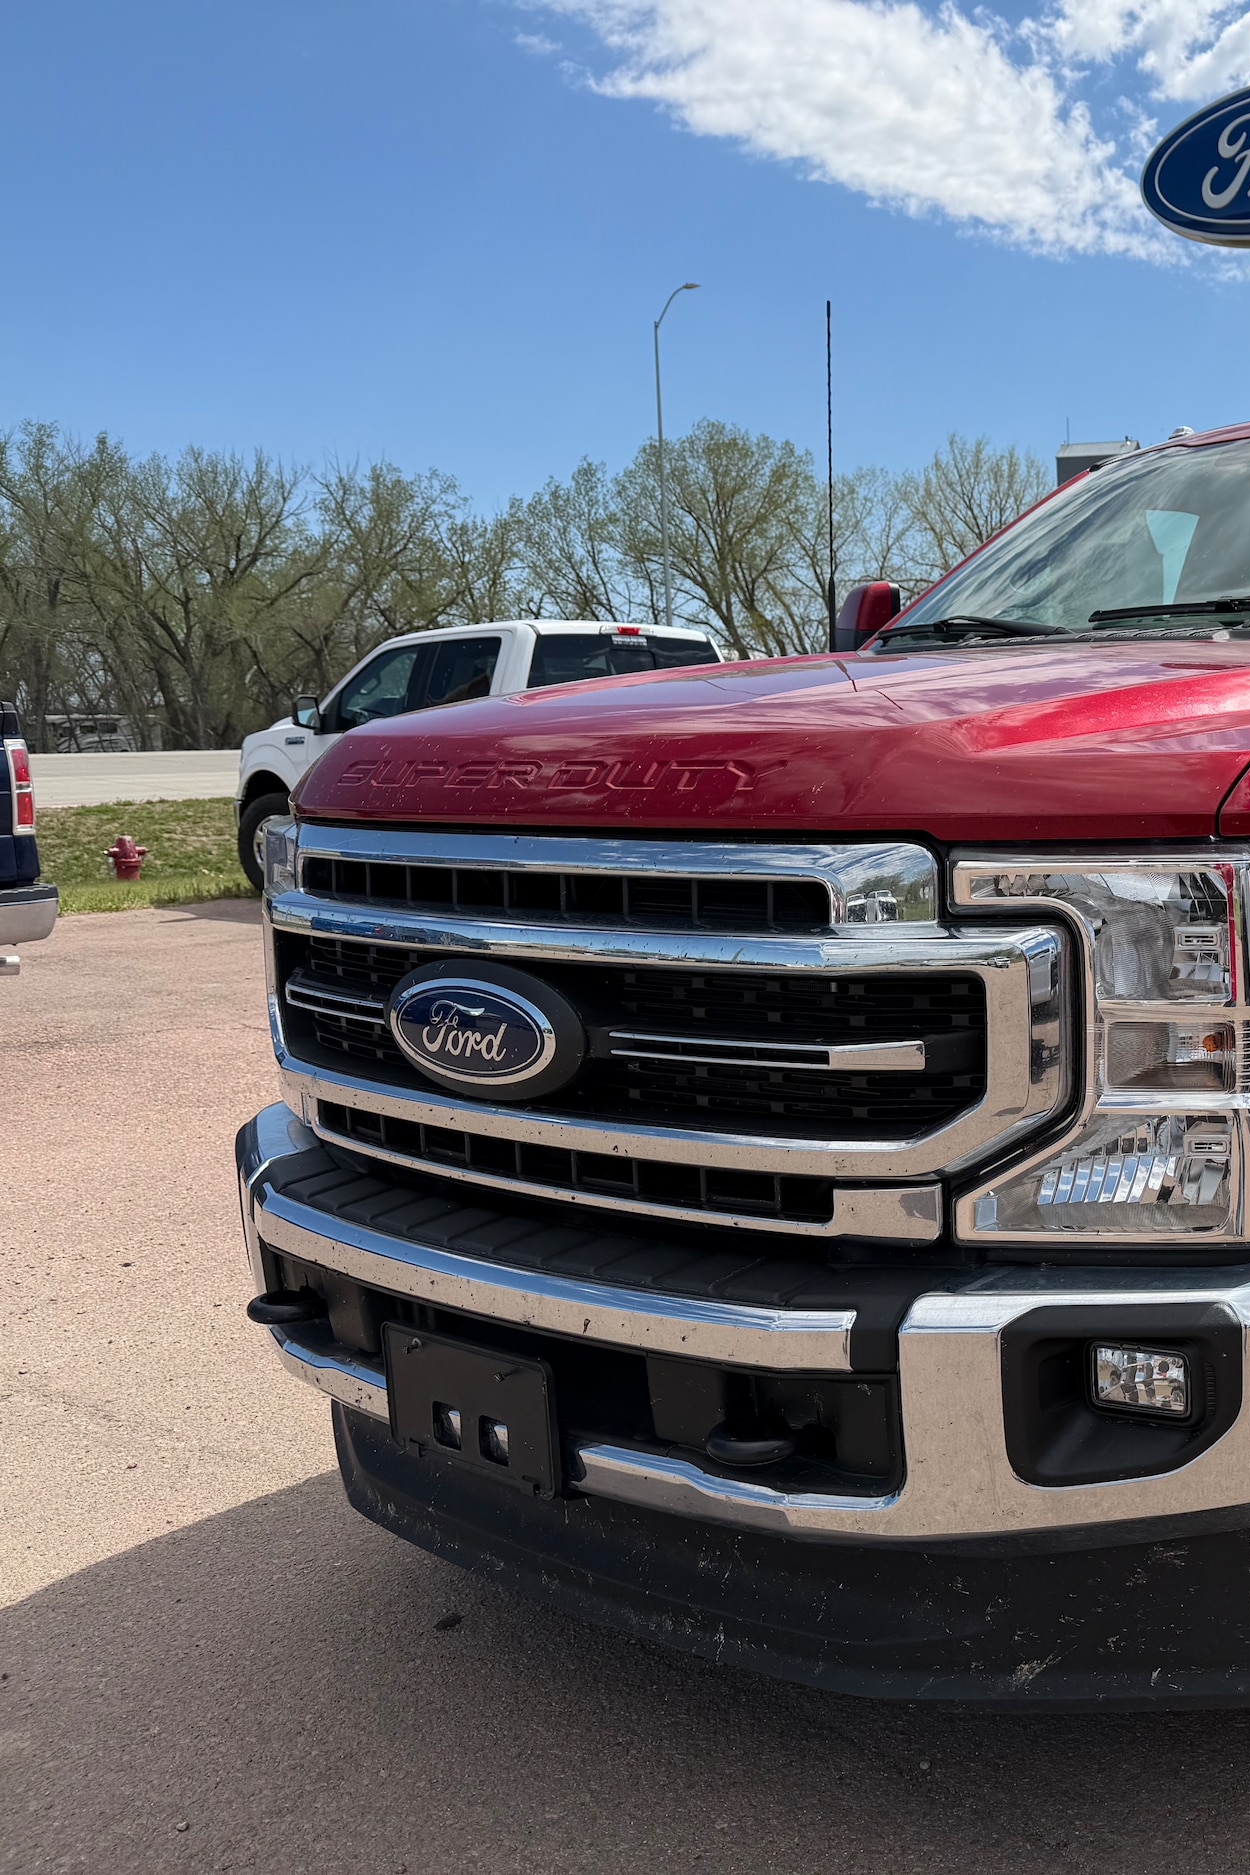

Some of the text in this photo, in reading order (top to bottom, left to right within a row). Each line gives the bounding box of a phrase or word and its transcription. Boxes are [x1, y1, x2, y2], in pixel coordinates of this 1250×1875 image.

[337, 759, 788, 791] SUPER DUTY
[422, 1000, 508, 1062] Ford
